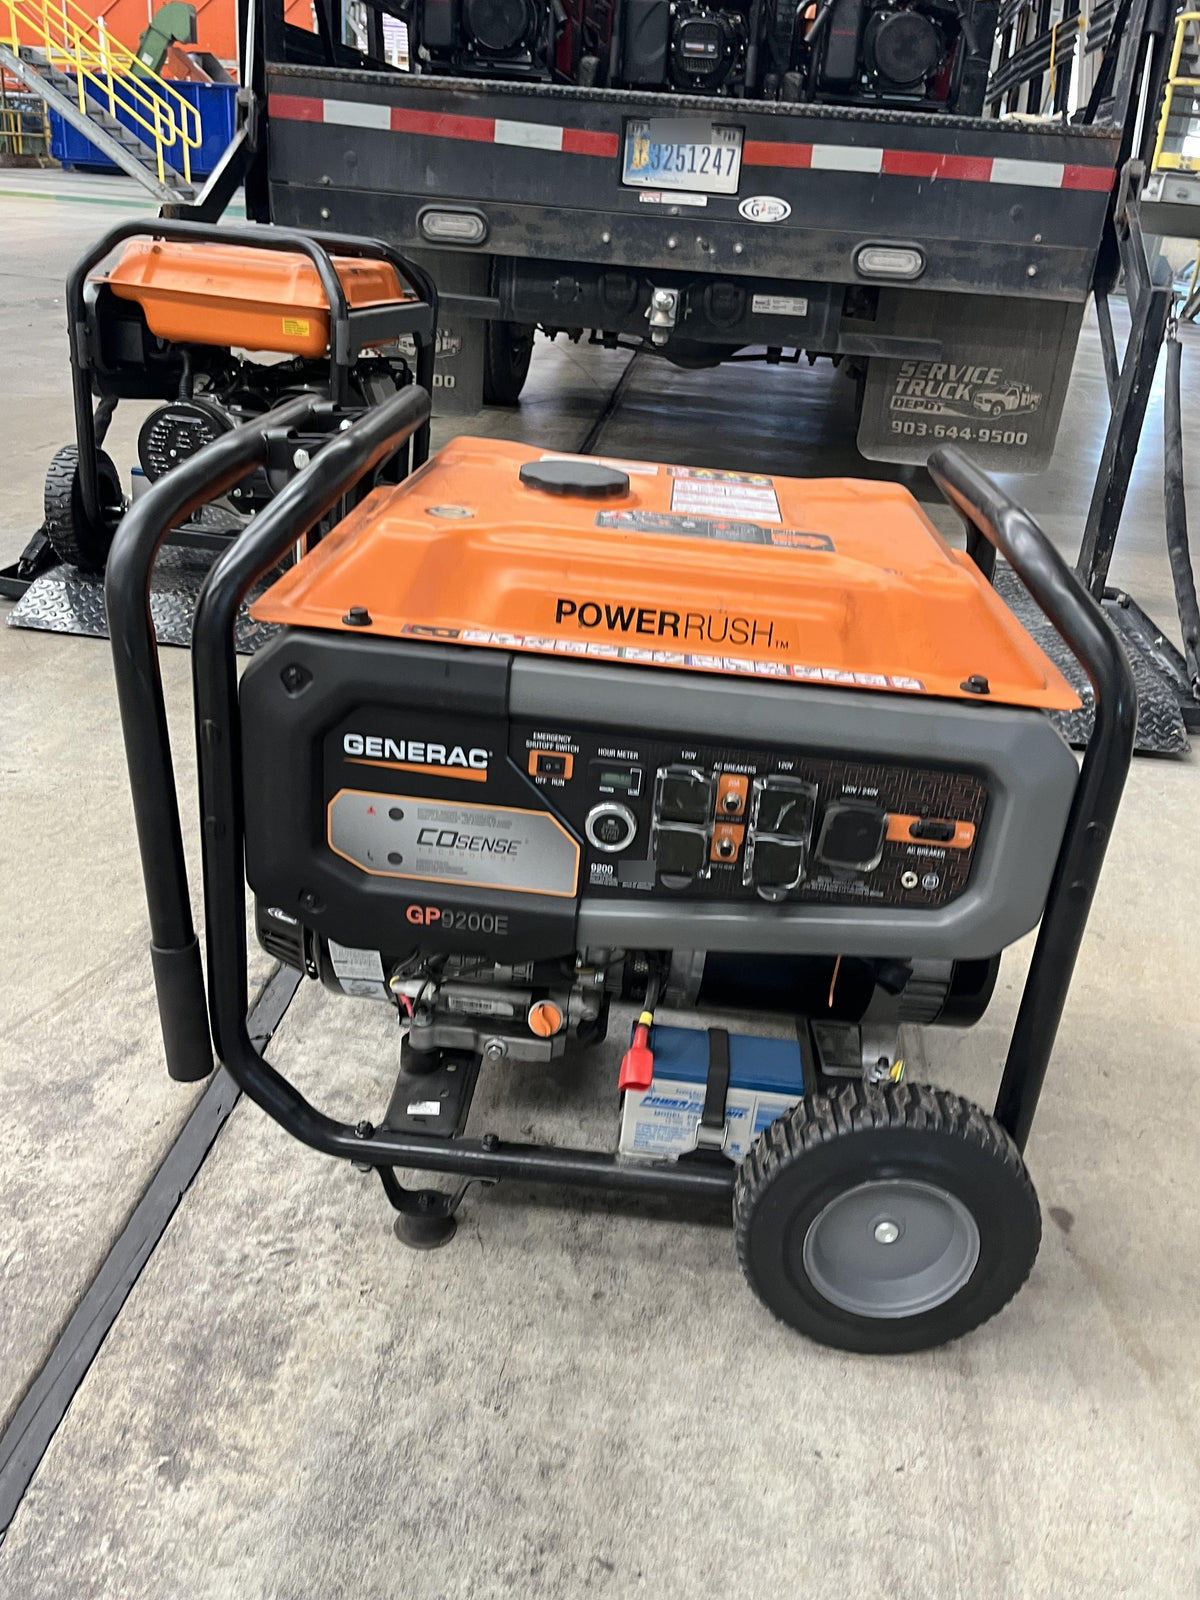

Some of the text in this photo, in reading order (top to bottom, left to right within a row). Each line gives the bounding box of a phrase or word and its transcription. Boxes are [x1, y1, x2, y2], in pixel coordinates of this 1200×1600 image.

[650, 143, 737, 177] 3251247
[899, 361, 1003, 385] SERVICE
[895, 377, 973, 401] TRUCK
[892, 396, 946, 413] DEPOT
[525, 739, 580, 754] SHUTOFF SWITCH
[533, 731, 571, 744] EMERGENCY
[343, 733, 488, 769] GENERAC
[598, 747, 639, 760] HOUR METER
[416, 827, 522, 856] COSENSE
[405, 904, 509, 935] GP9200E
